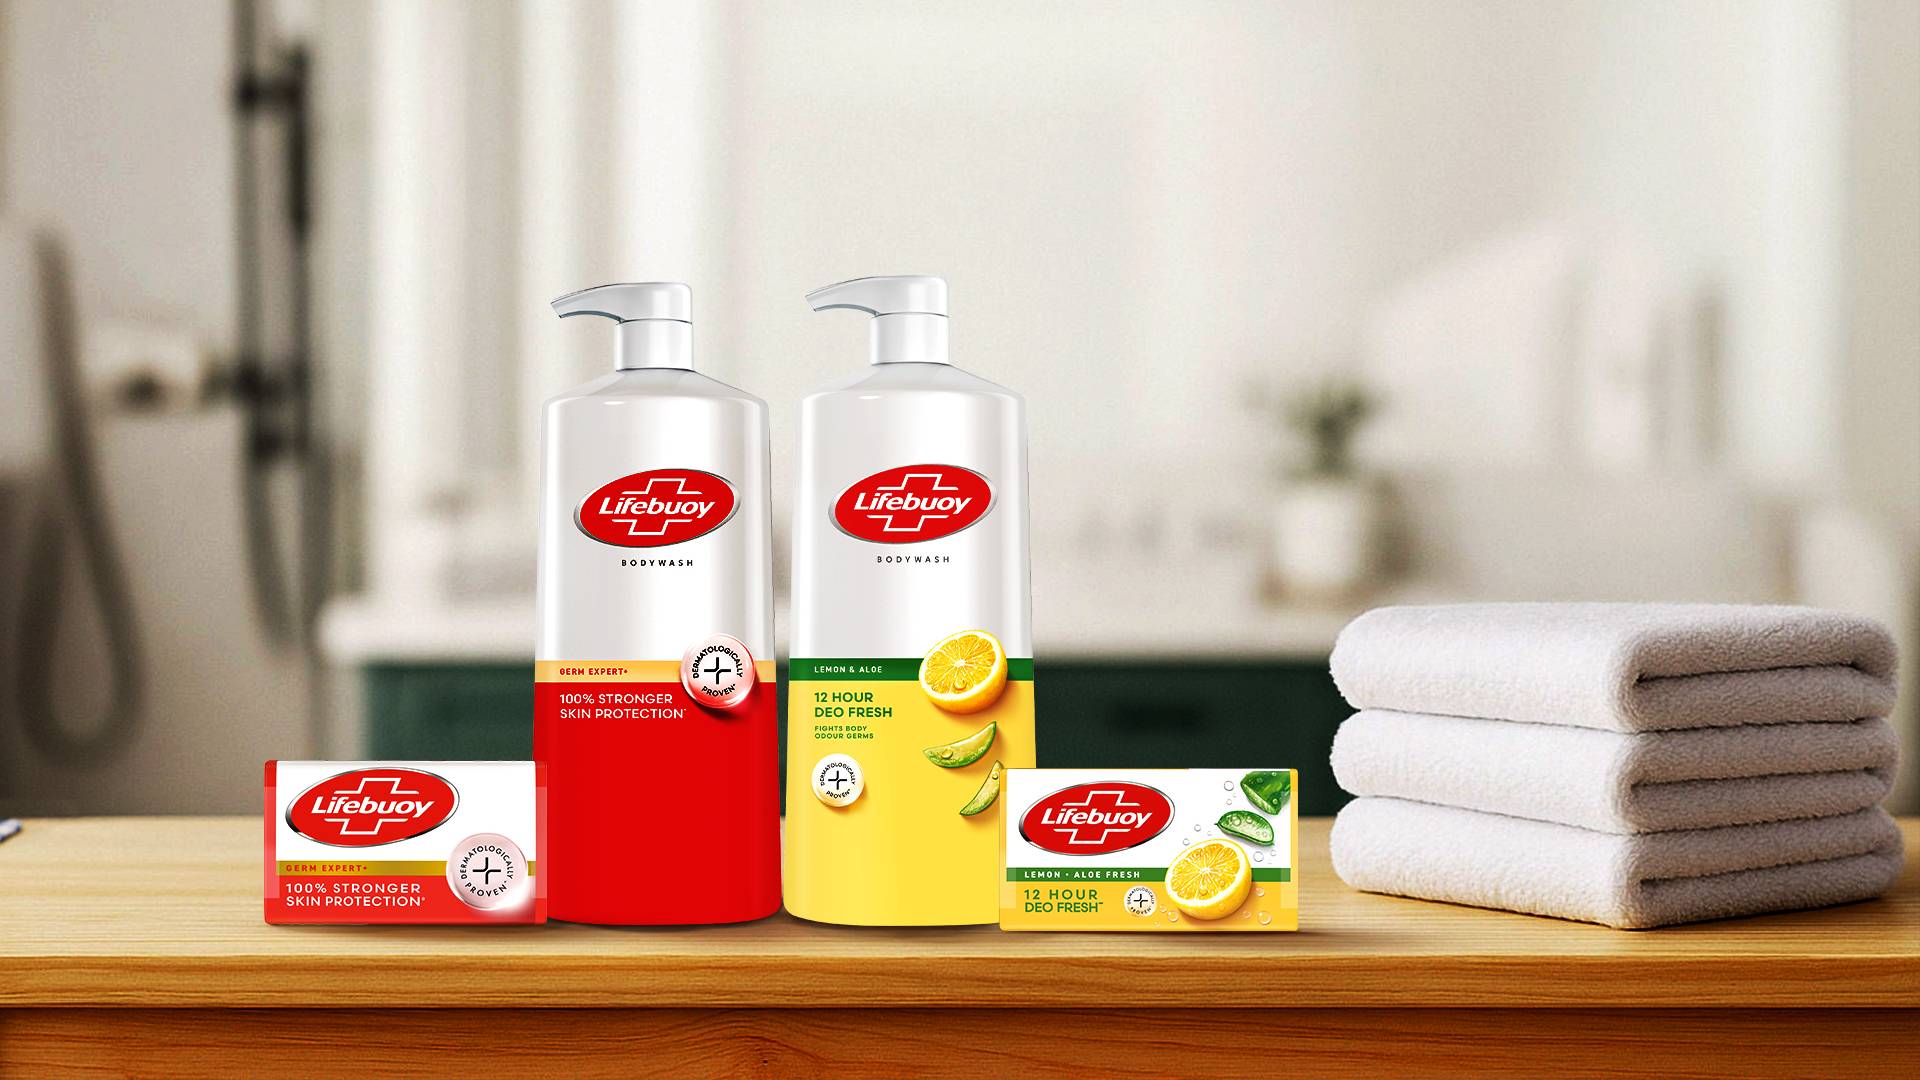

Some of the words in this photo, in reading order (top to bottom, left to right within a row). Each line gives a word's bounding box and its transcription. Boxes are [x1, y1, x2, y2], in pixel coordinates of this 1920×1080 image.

[598, 497, 716, 519] Lifebuoy
[853, 493, 972, 515] Lifebuoy
[621, 559, 694, 567] BODYWASH
[692, 645, 743, 679] DERMATOLOGICALLY
[559, 668, 585, 676] GERM
[559, 694, 595, 704] 100%
[599, 694, 673, 704] STRONGER
[814, 692, 828, 703] 12
[832, 692, 874, 703] HOUR
[559, 709, 591, 719] SKIN
[814, 707, 845, 718] DEO
[848, 707, 893, 718] FRESH
[311, 796, 435, 818] Lifebuoy
[1041, 808, 1153, 829] Lifebuoy
[460, 845, 513, 880] DERMATOLOGICALLY
[286, 883, 327, 893] 100%
[333, 883, 420, 893] STRONGER
[1024, 889, 1040, 900] 12
[1049, 889, 1098, 900] HOUR
[286, 896, 321, 907] SKIN
[1024, 902, 1053, 912] DEO
